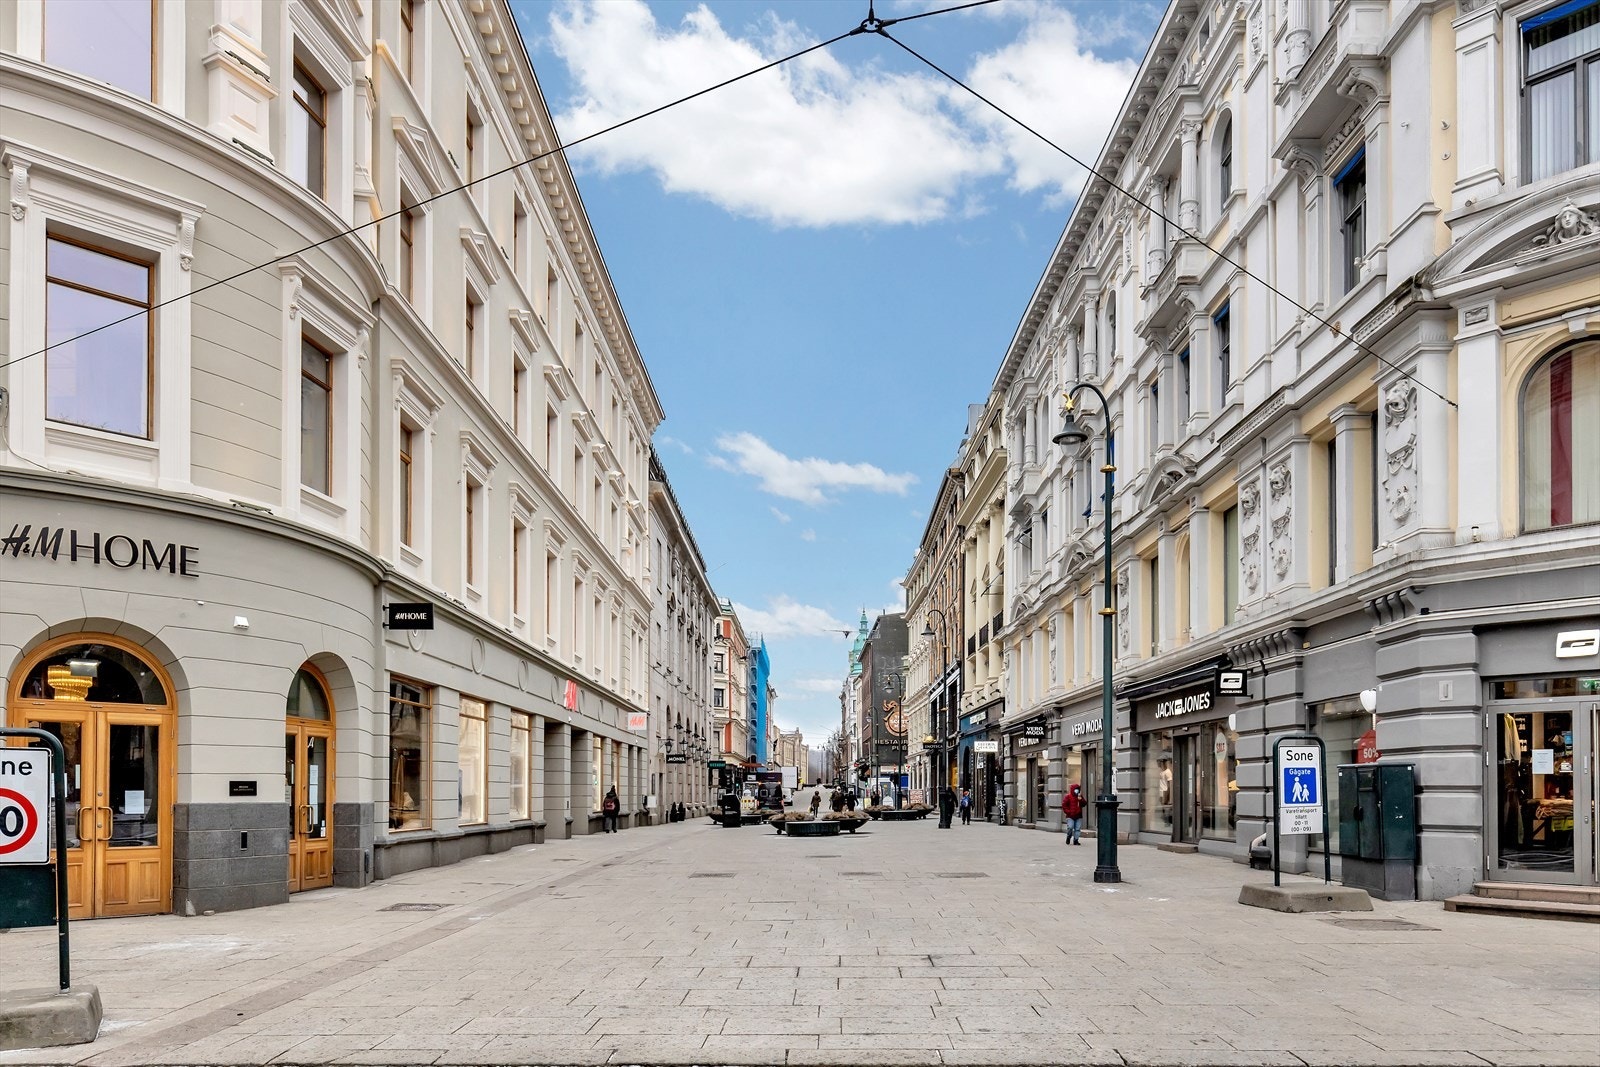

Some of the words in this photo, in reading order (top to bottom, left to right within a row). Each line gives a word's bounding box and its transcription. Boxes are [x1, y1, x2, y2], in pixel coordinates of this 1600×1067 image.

[1, 523, 64, 561] H&M
[70, 529, 199, 578] HOME
[404, 612, 427, 620] HOME
[1155, 700, 1175, 718] JACK
[1181, 691, 1210, 714] JONES
[1071, 722, 1085, 736] VERO
[1086, 718, 1103, 733] MODA
[1286, 750, 1313, 761] Sone
[1363, 747, 1379, 759] 50%
[1289, 768, 1311, 776] Gågate
